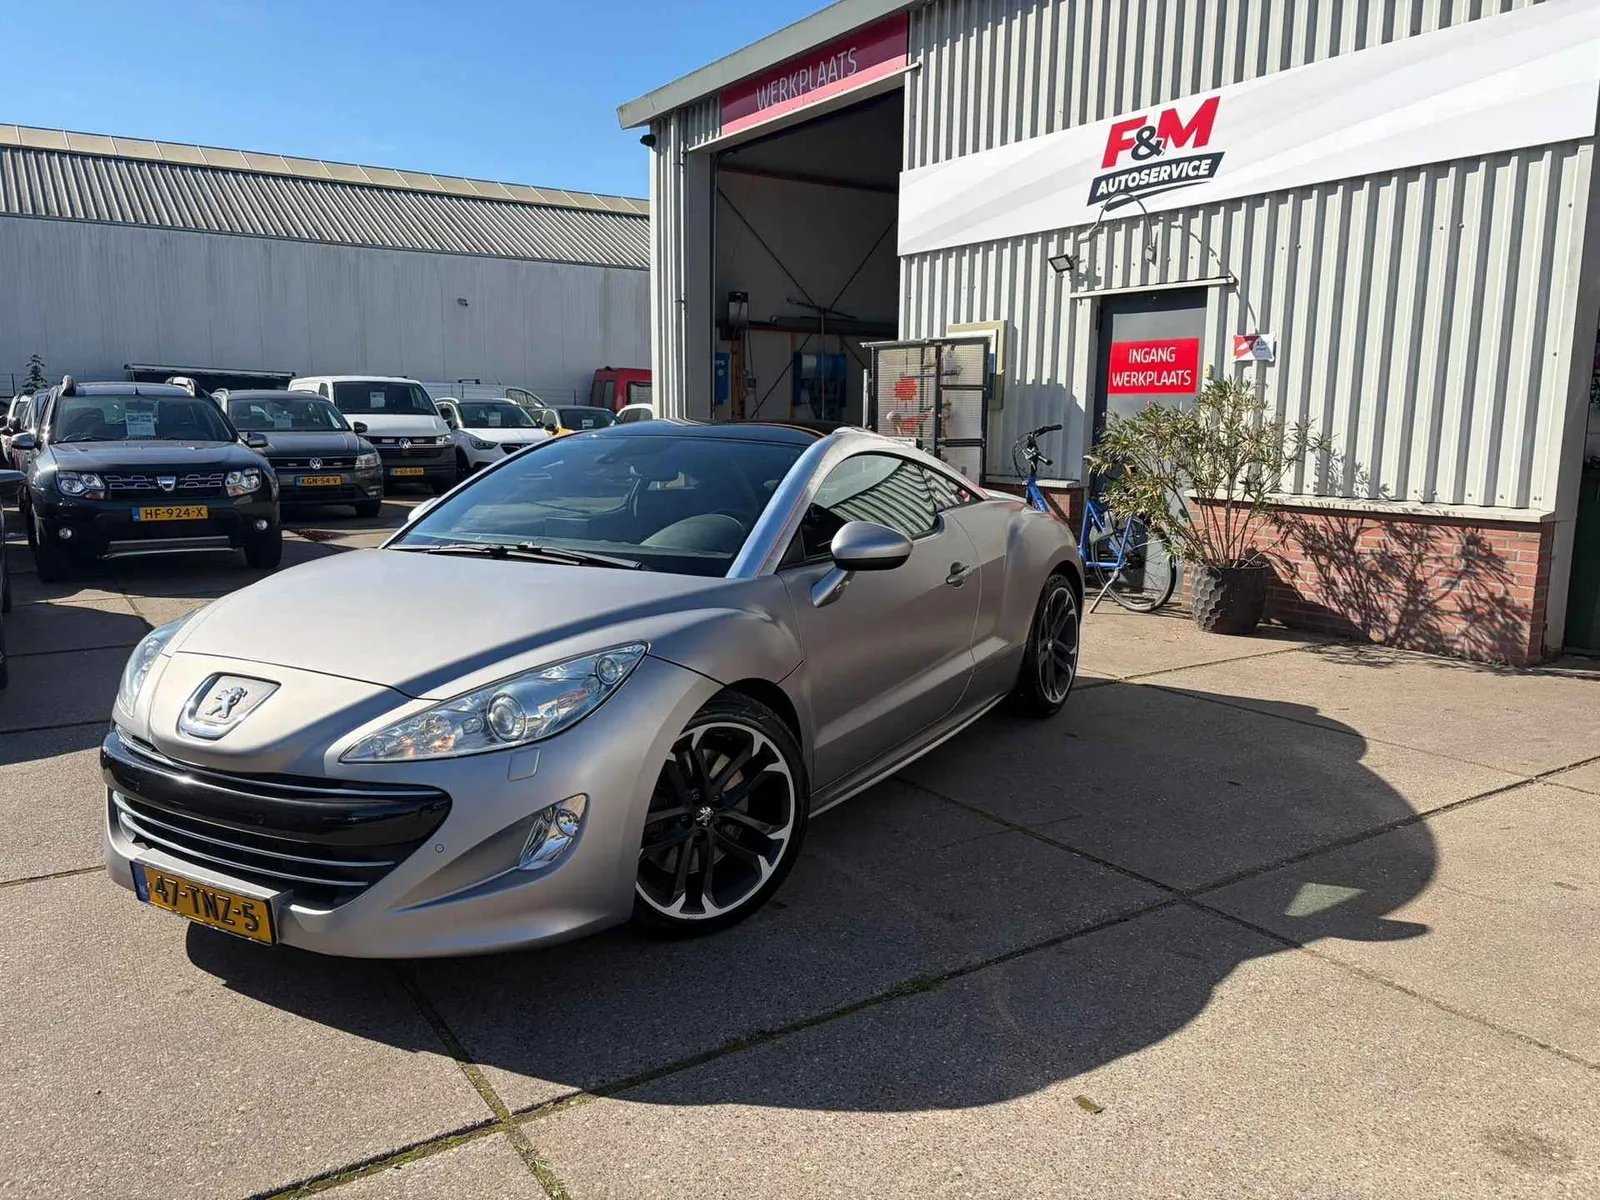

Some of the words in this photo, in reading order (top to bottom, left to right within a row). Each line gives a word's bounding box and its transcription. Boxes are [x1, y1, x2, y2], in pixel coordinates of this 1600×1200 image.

[756, 48, 858, 111] WERKPLAATS
[1101, 96, 1220, 169] F&M
[1096, 159, 1212, 196] AUTOSERVICE
[1128, 346, 1176, 363] INGANG
[1112, 369, 1192, 387] WERKPLAATS
[144, 507, 204, 519] HF-924-X
[154, 875, 260, 933] 47-TNZ-5
